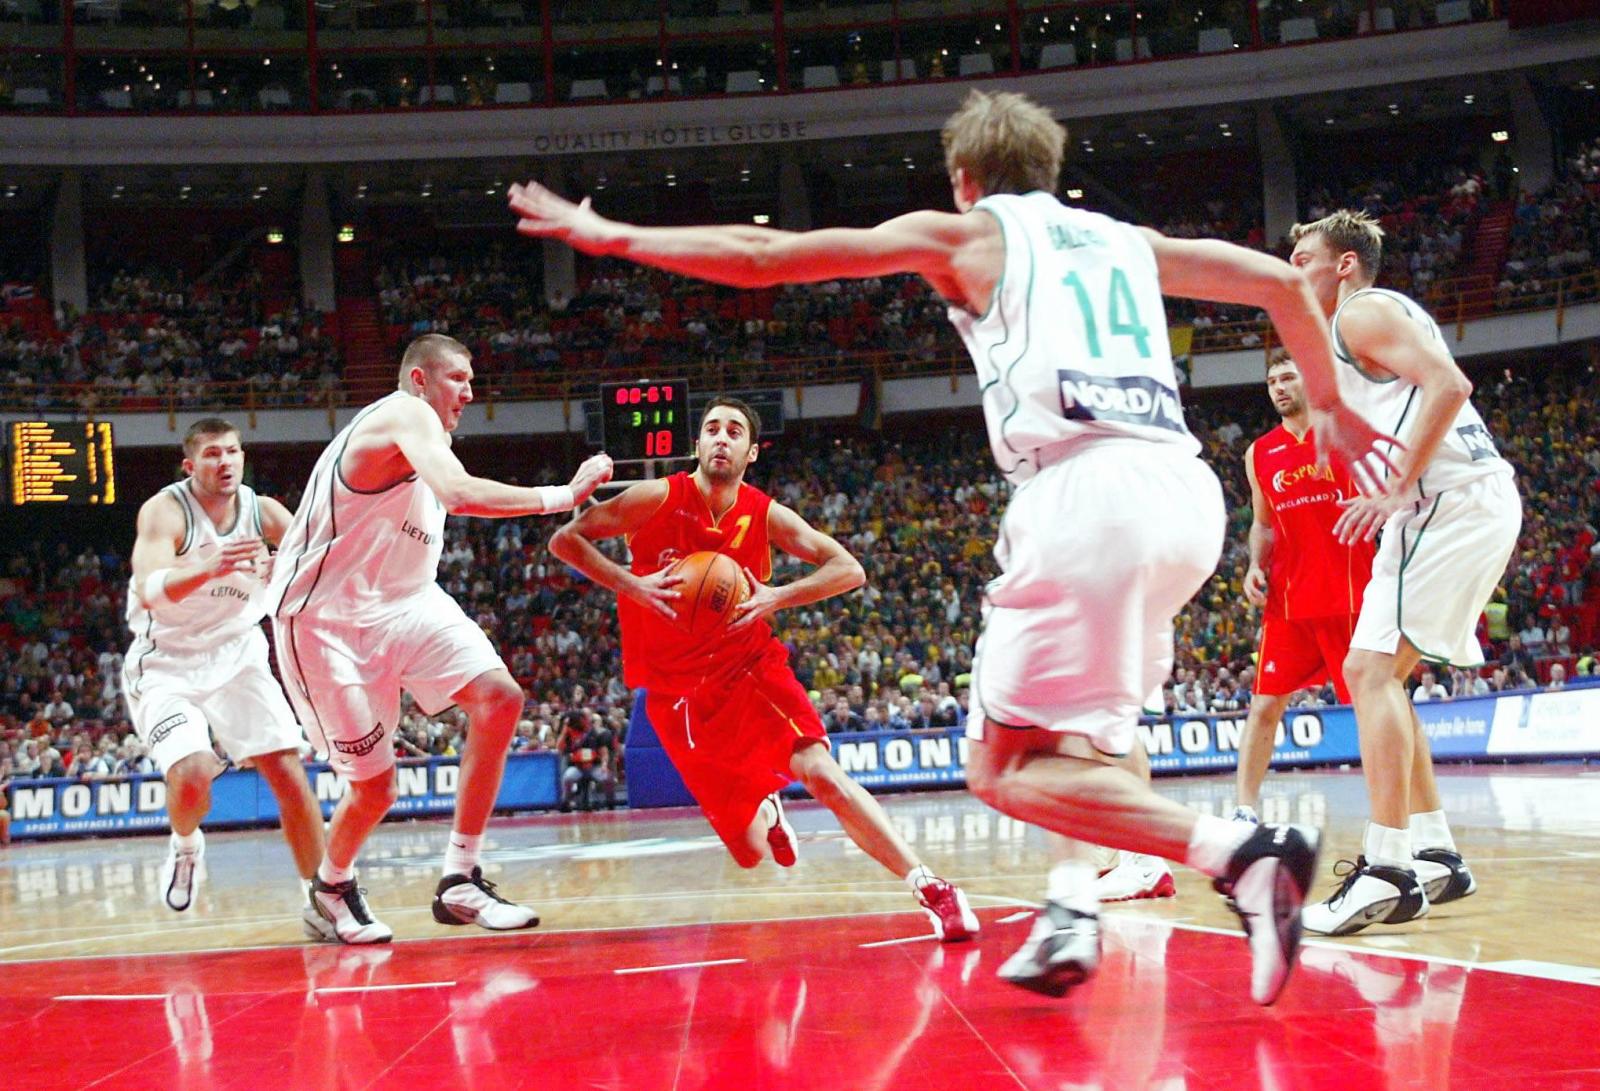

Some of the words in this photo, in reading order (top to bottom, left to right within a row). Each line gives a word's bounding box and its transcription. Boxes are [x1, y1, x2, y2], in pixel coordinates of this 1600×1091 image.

[534, 130, 632, 151] QUALITY
[643, 126, 719, 146] HOTEL
[727, 120, 806, 141] GLOBE
[1061, 266, 1152, 358] 14
[645, 430, 673, 456] 18
[401, 520, 434, 545] LIETU
[839, 737, 970, 773] MON
[1185, 754, 1236, 767] SURFACES
[316, 765, 459, 801] MND
[13, 780, 167, 819] MOND
[26, 822, 59, 832] SPORT
[65, 818, 115, 831] SURFACES
[129, 815, 170, 826] EQUIPM
